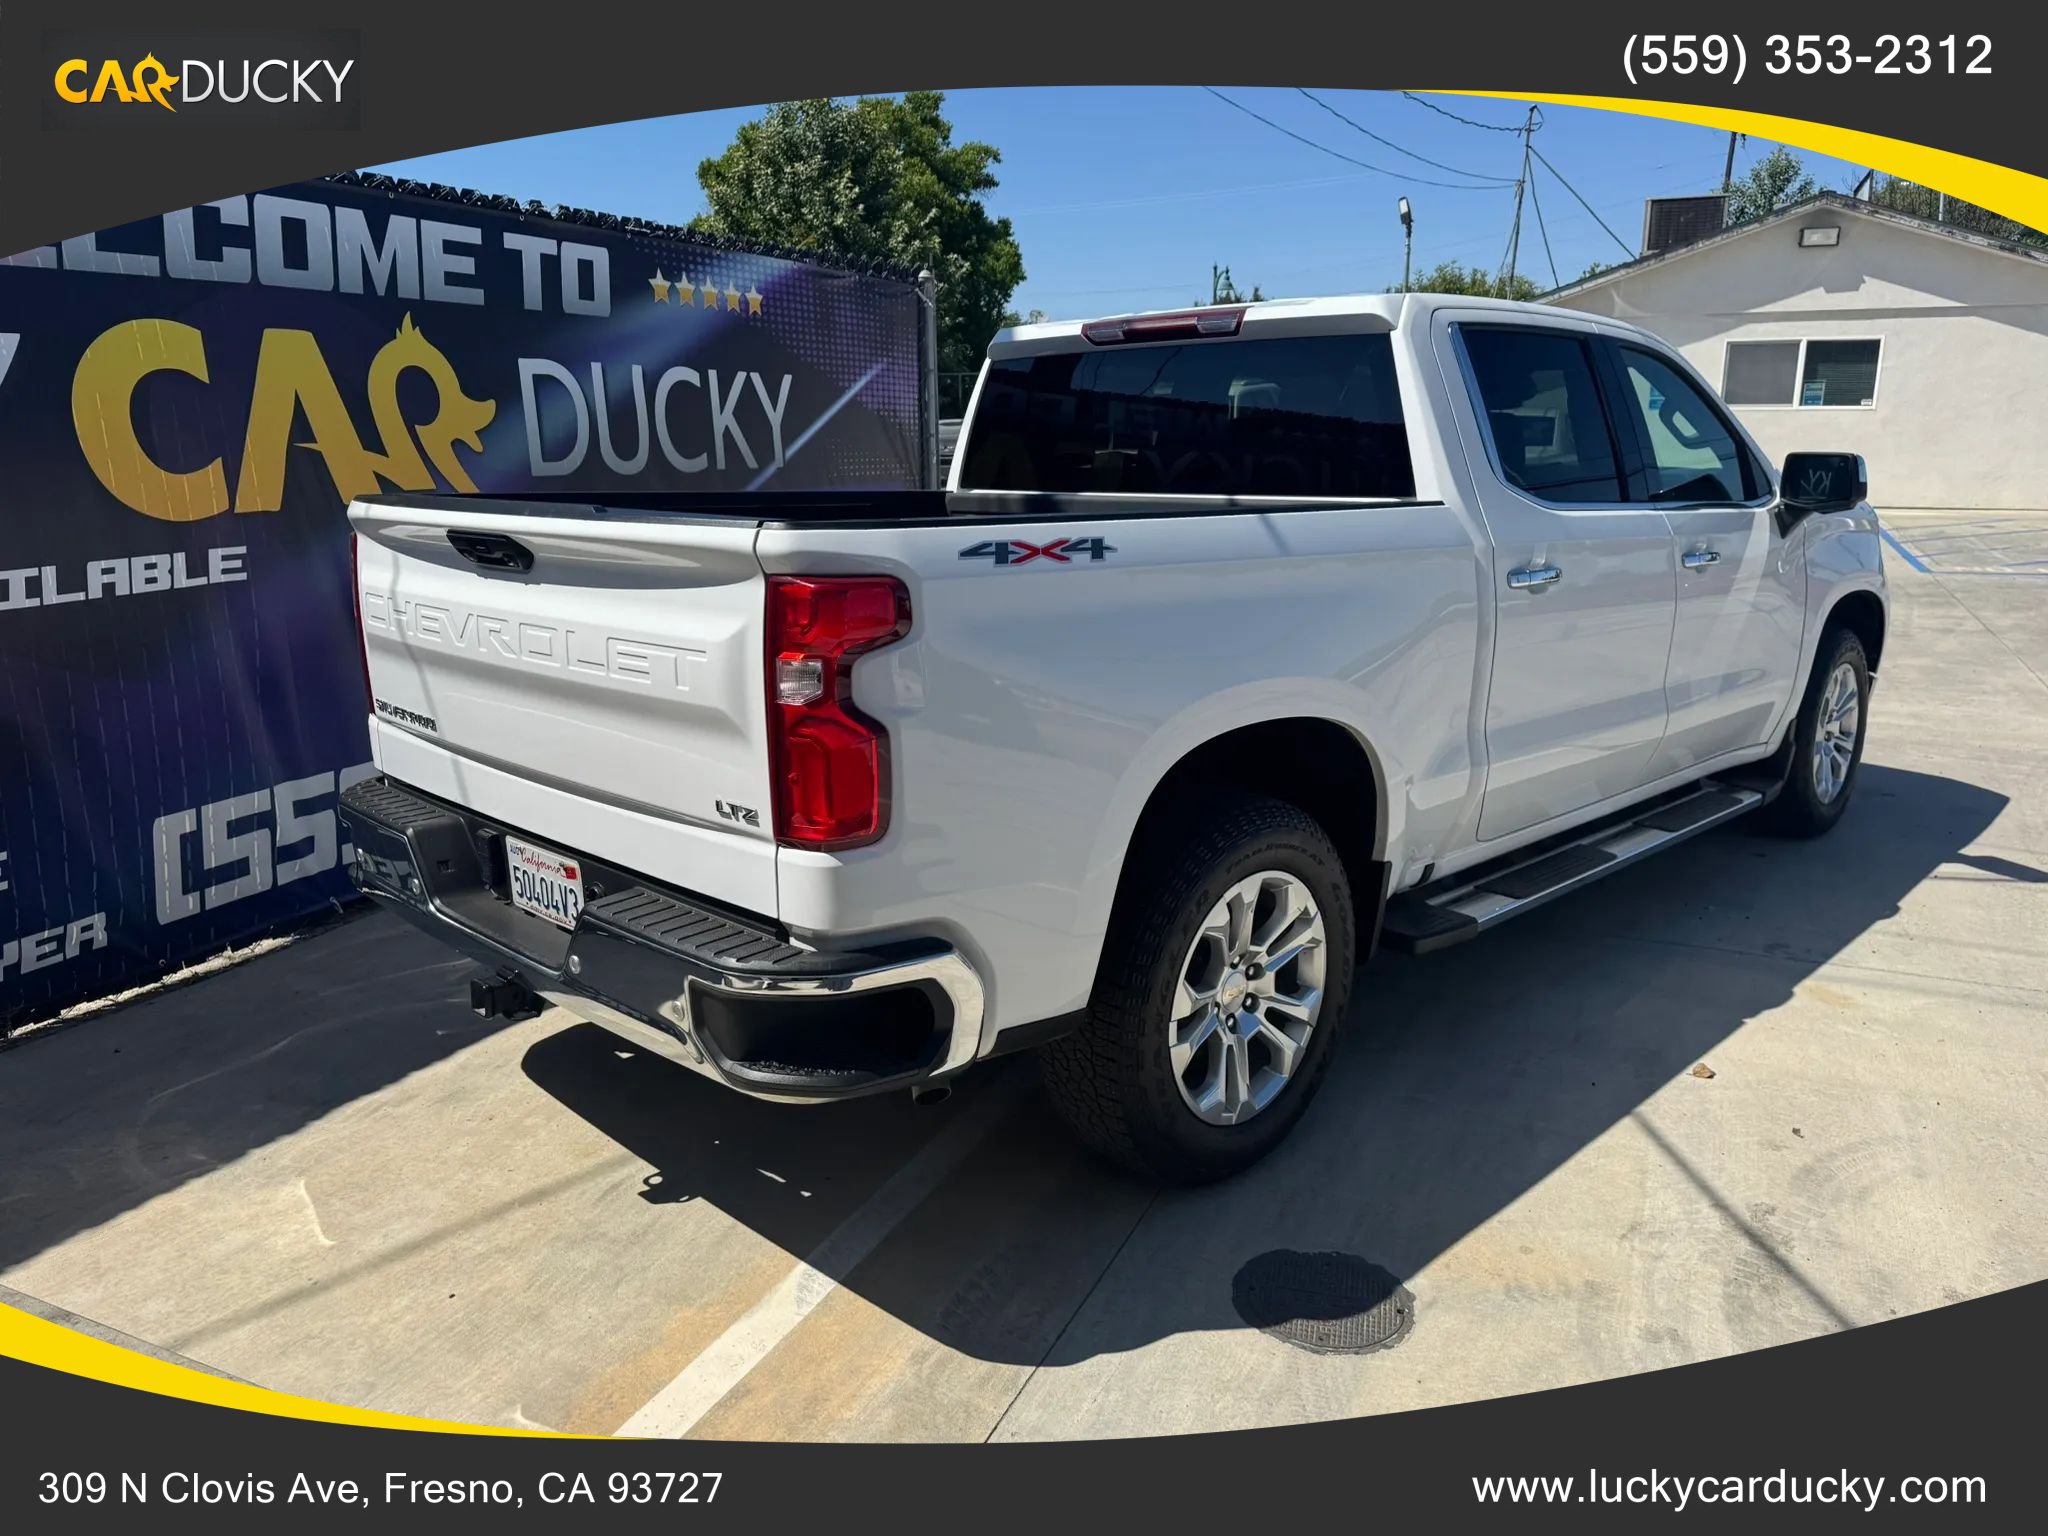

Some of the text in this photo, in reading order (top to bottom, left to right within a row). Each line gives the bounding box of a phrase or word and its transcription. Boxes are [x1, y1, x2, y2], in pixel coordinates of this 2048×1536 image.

[503, 232, 611, 318] TO
[72, 311, 793, 522] CAR DUCKY
[365, 592, 707, 692] CHEVROLET
[715, 799, 761, 828] LTZ
[512, 864, 580, 919] 50404V3
